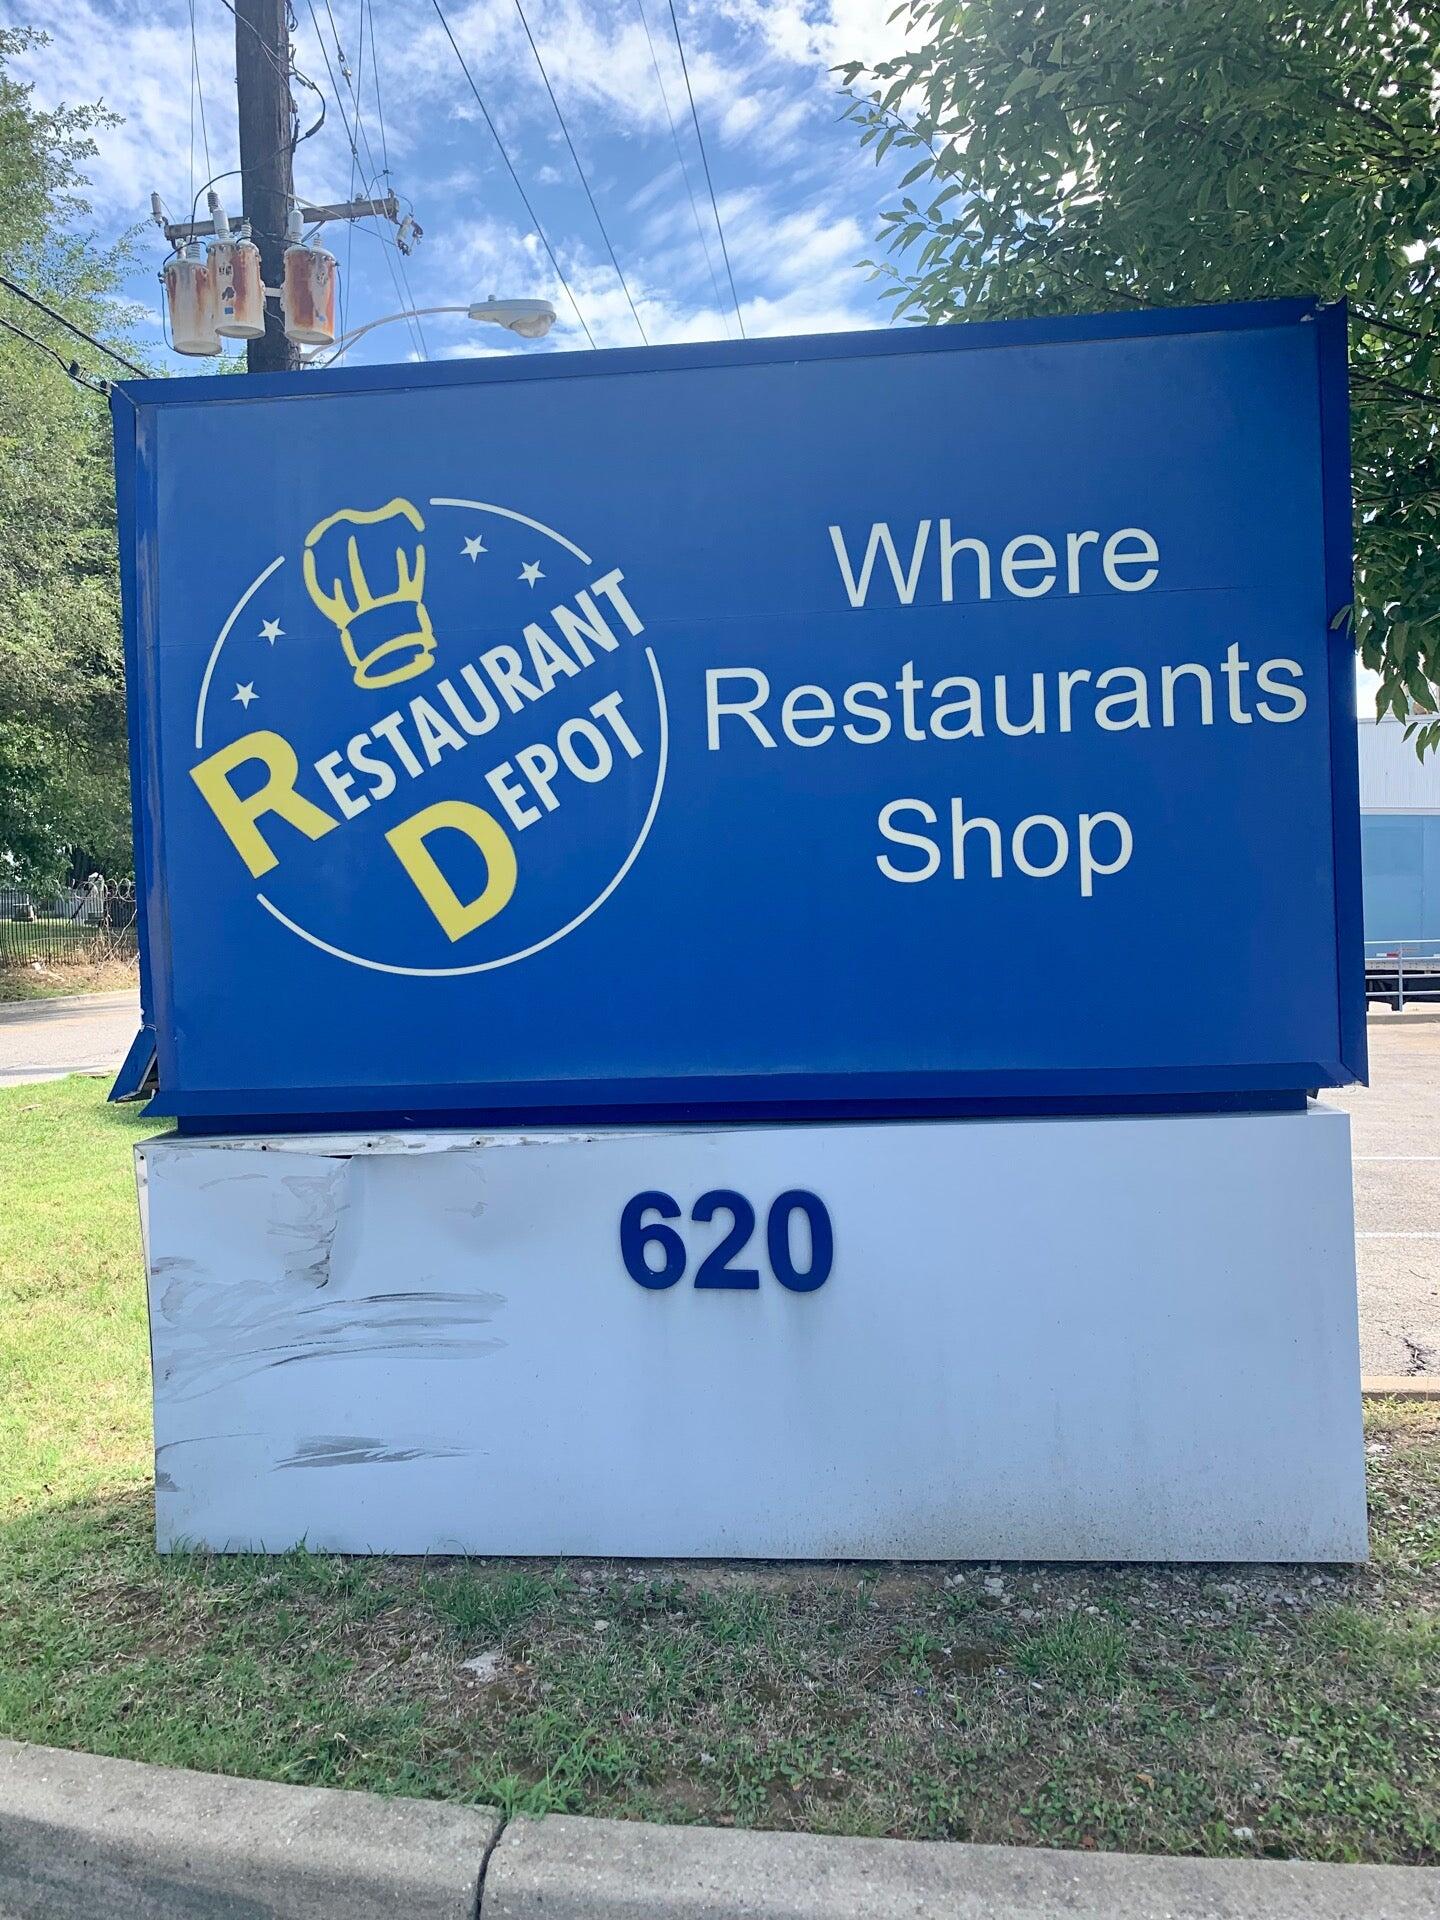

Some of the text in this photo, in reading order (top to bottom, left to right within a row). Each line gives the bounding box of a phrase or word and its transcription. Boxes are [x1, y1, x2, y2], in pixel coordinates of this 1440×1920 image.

[828, 518, 1159, 608] Where
[189, 567, 645, 879] RESTAURANT
[705, 642, 1307, 751] Restaurants
[384, 690, 643, 943] DEPOT
[876, 797, 1133, 897] Shop
[619, 1188, 834, 1296] 620
